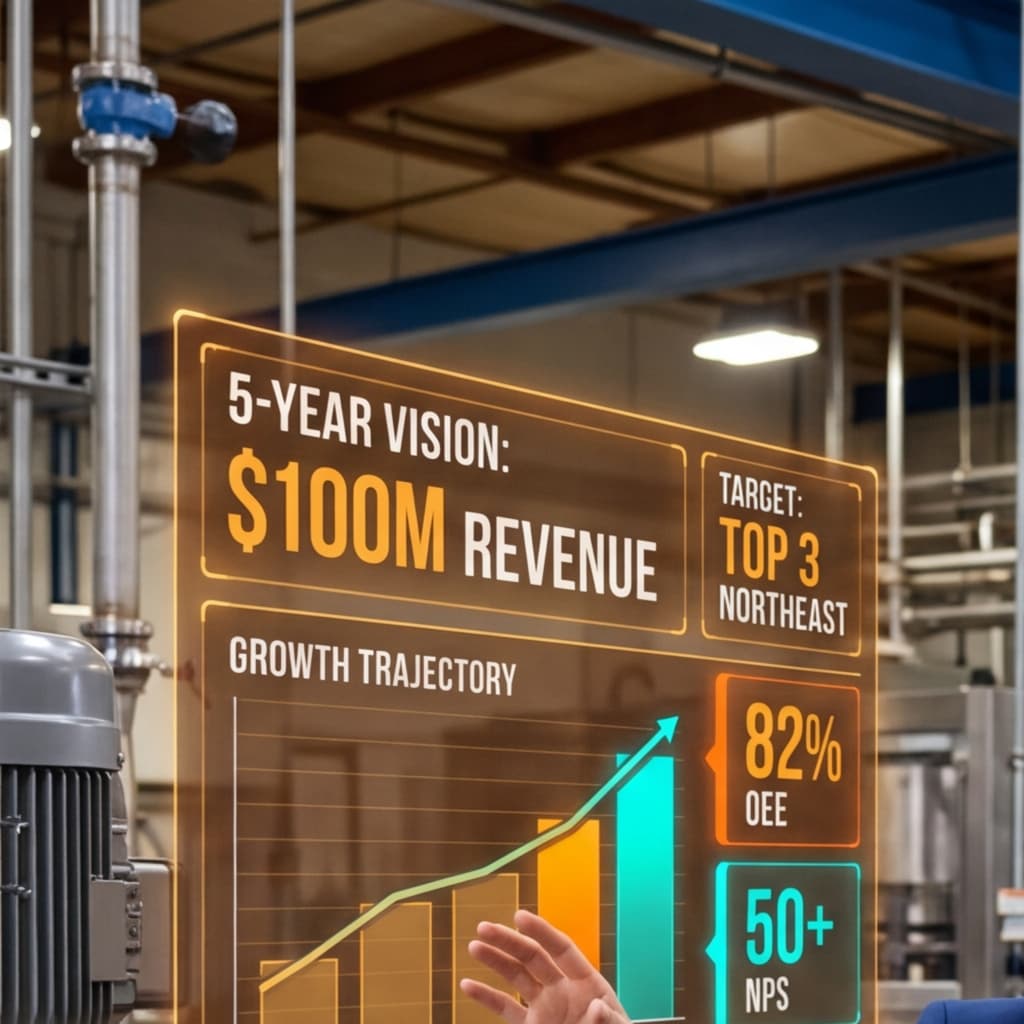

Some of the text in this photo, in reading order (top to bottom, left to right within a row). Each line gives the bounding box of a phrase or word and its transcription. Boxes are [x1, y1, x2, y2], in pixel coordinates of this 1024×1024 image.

[229, 371, 509, 473] 5-YEAR VISION:
[228, 447, 657, 602] $100M REVENUE
[719, 471, 805, 520] TARGET:
[719, 516, 819, 587] TOP 3
[719, 584, 848, 637] NORTHEAST
[229, 636, 517, 697] GROWTH TRAJECTORY
[746, 702, 842, 782] 82%
[745, 790, 787, 827] OEE
[746, 887, 834, 965] 50+
[745, 976, 789, 1013] NPS
